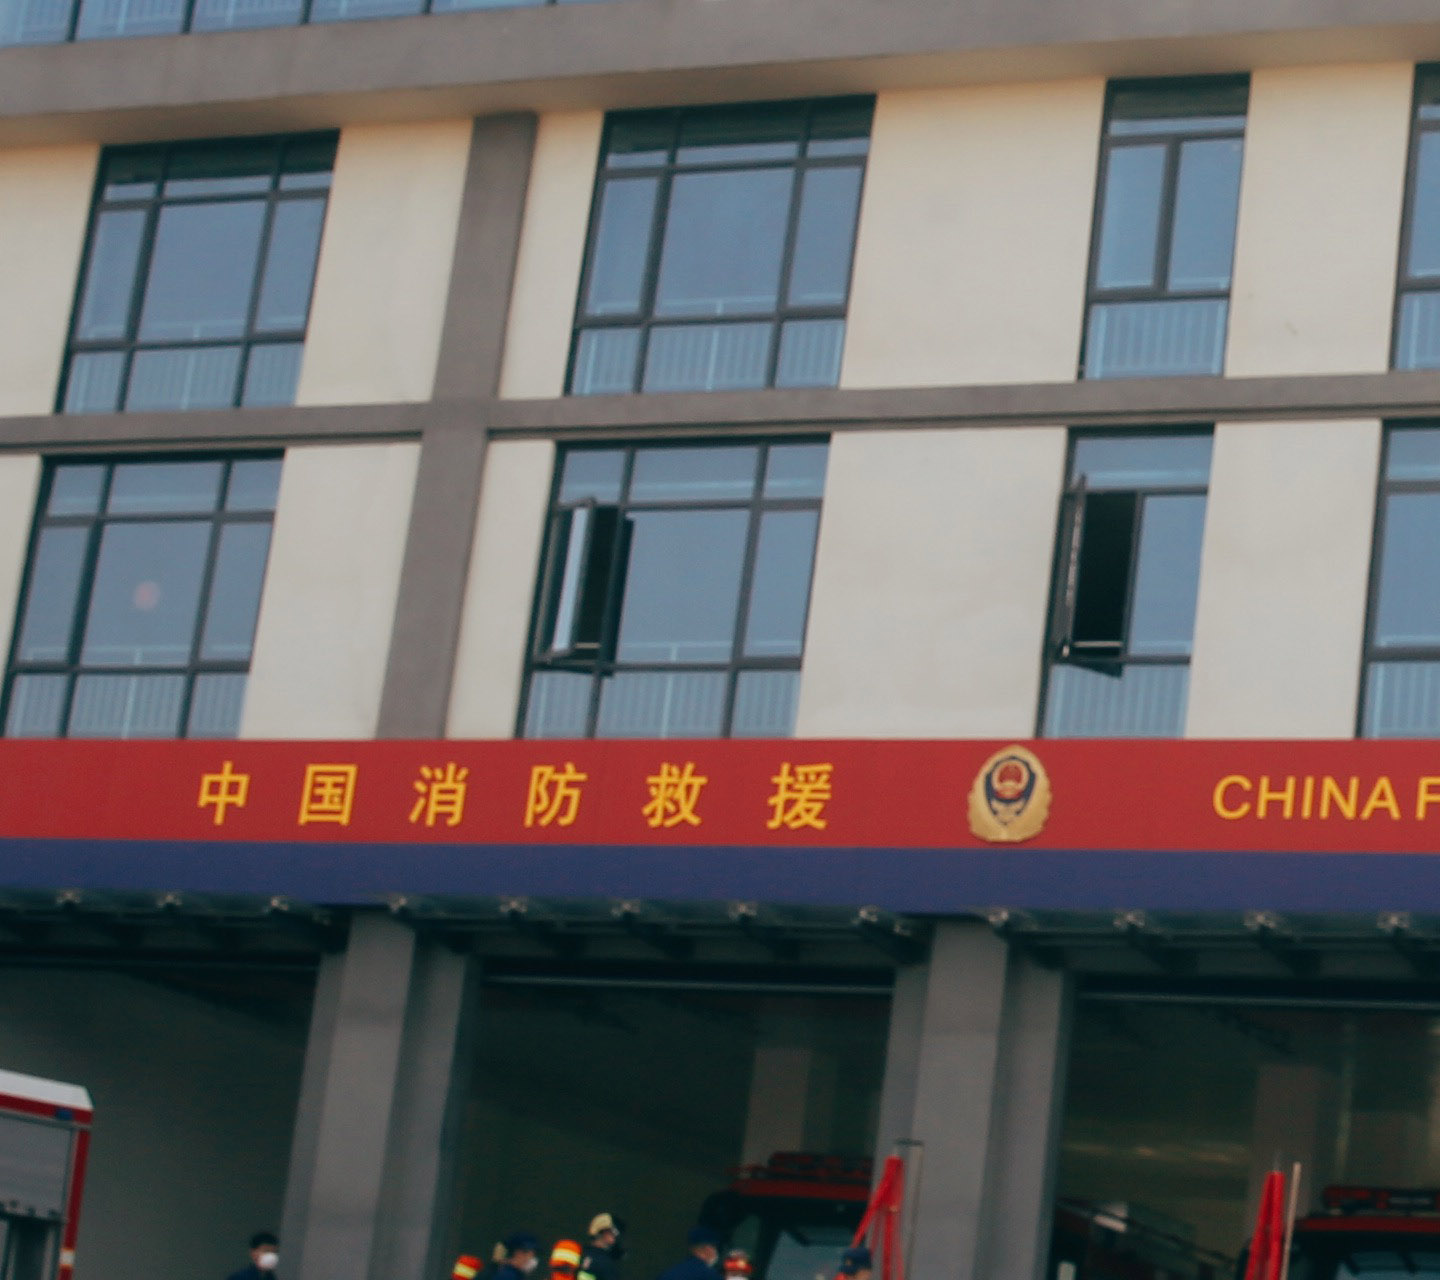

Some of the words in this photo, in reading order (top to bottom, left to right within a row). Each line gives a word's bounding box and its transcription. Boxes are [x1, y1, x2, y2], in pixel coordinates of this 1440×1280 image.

[196, 760, 835, 830] 中国消防救援
[1212, 774, 1401, 821] CHINA
